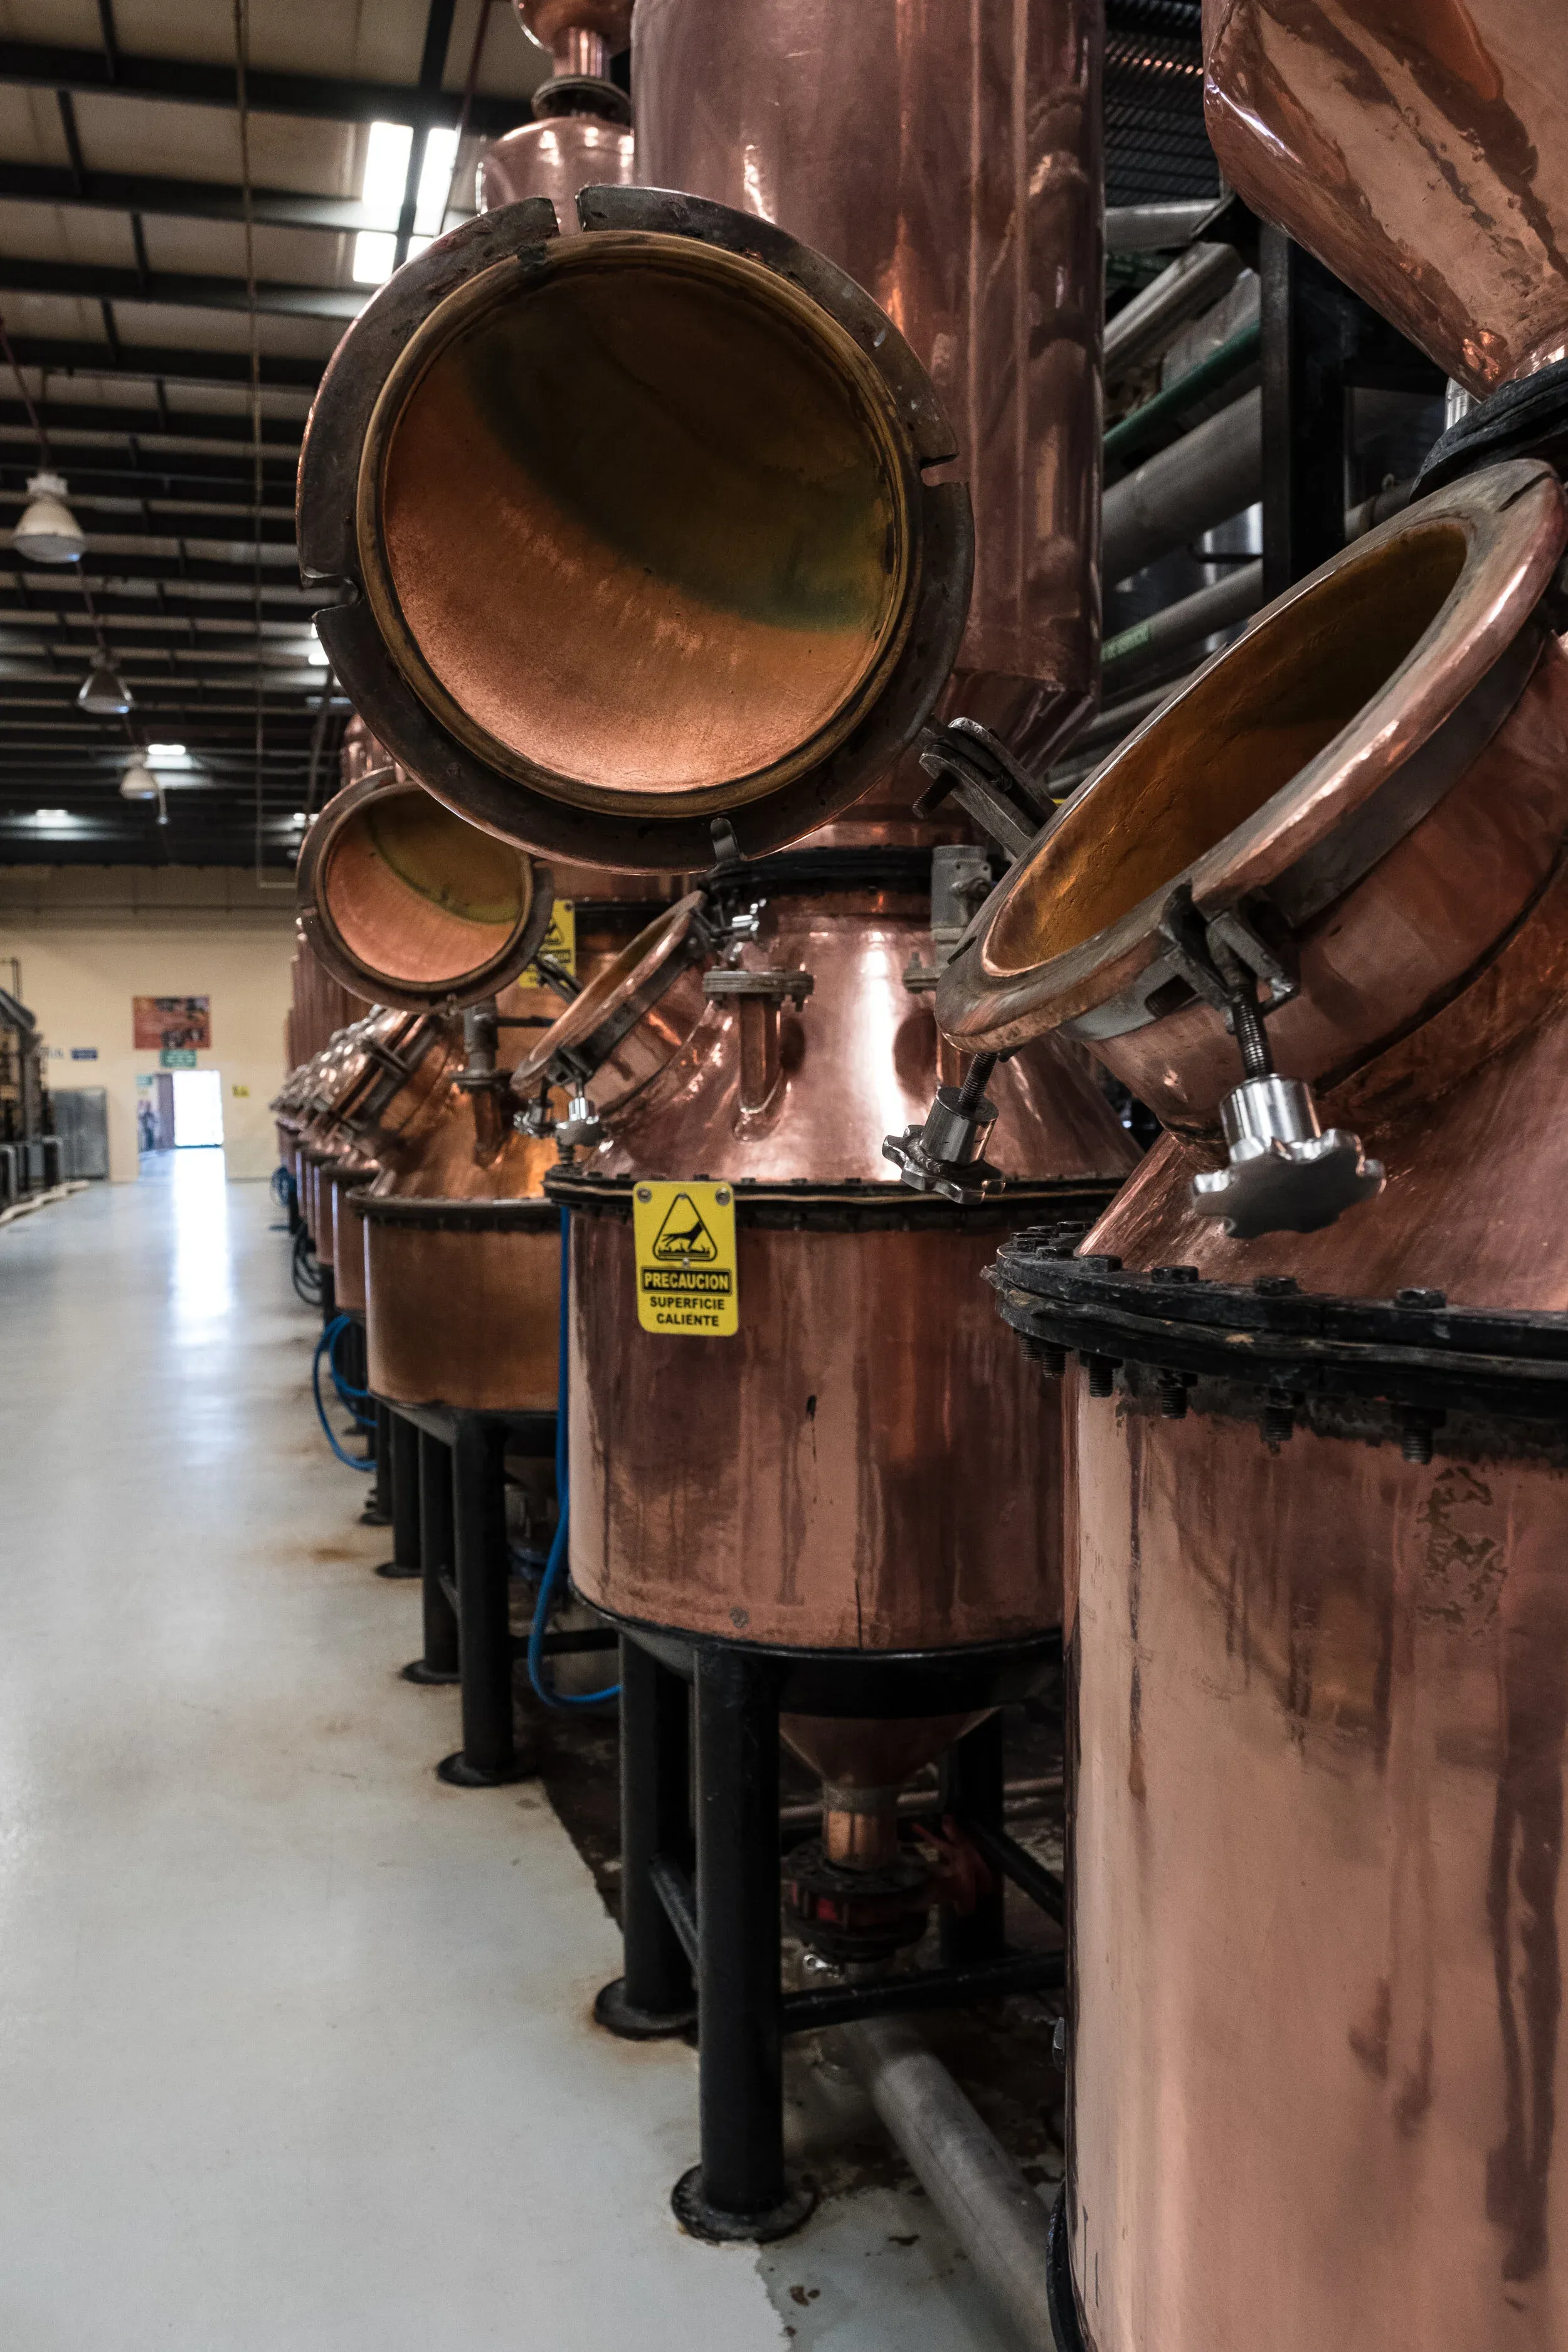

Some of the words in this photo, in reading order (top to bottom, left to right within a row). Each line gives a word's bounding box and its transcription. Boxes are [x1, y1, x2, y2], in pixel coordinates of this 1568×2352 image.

[645, 1273, 728, 1290] PRECAUCION
[650, 1296, 724, 1310] SUPERFICIE
[657, 1313, 719, 1327] CALIENTE
